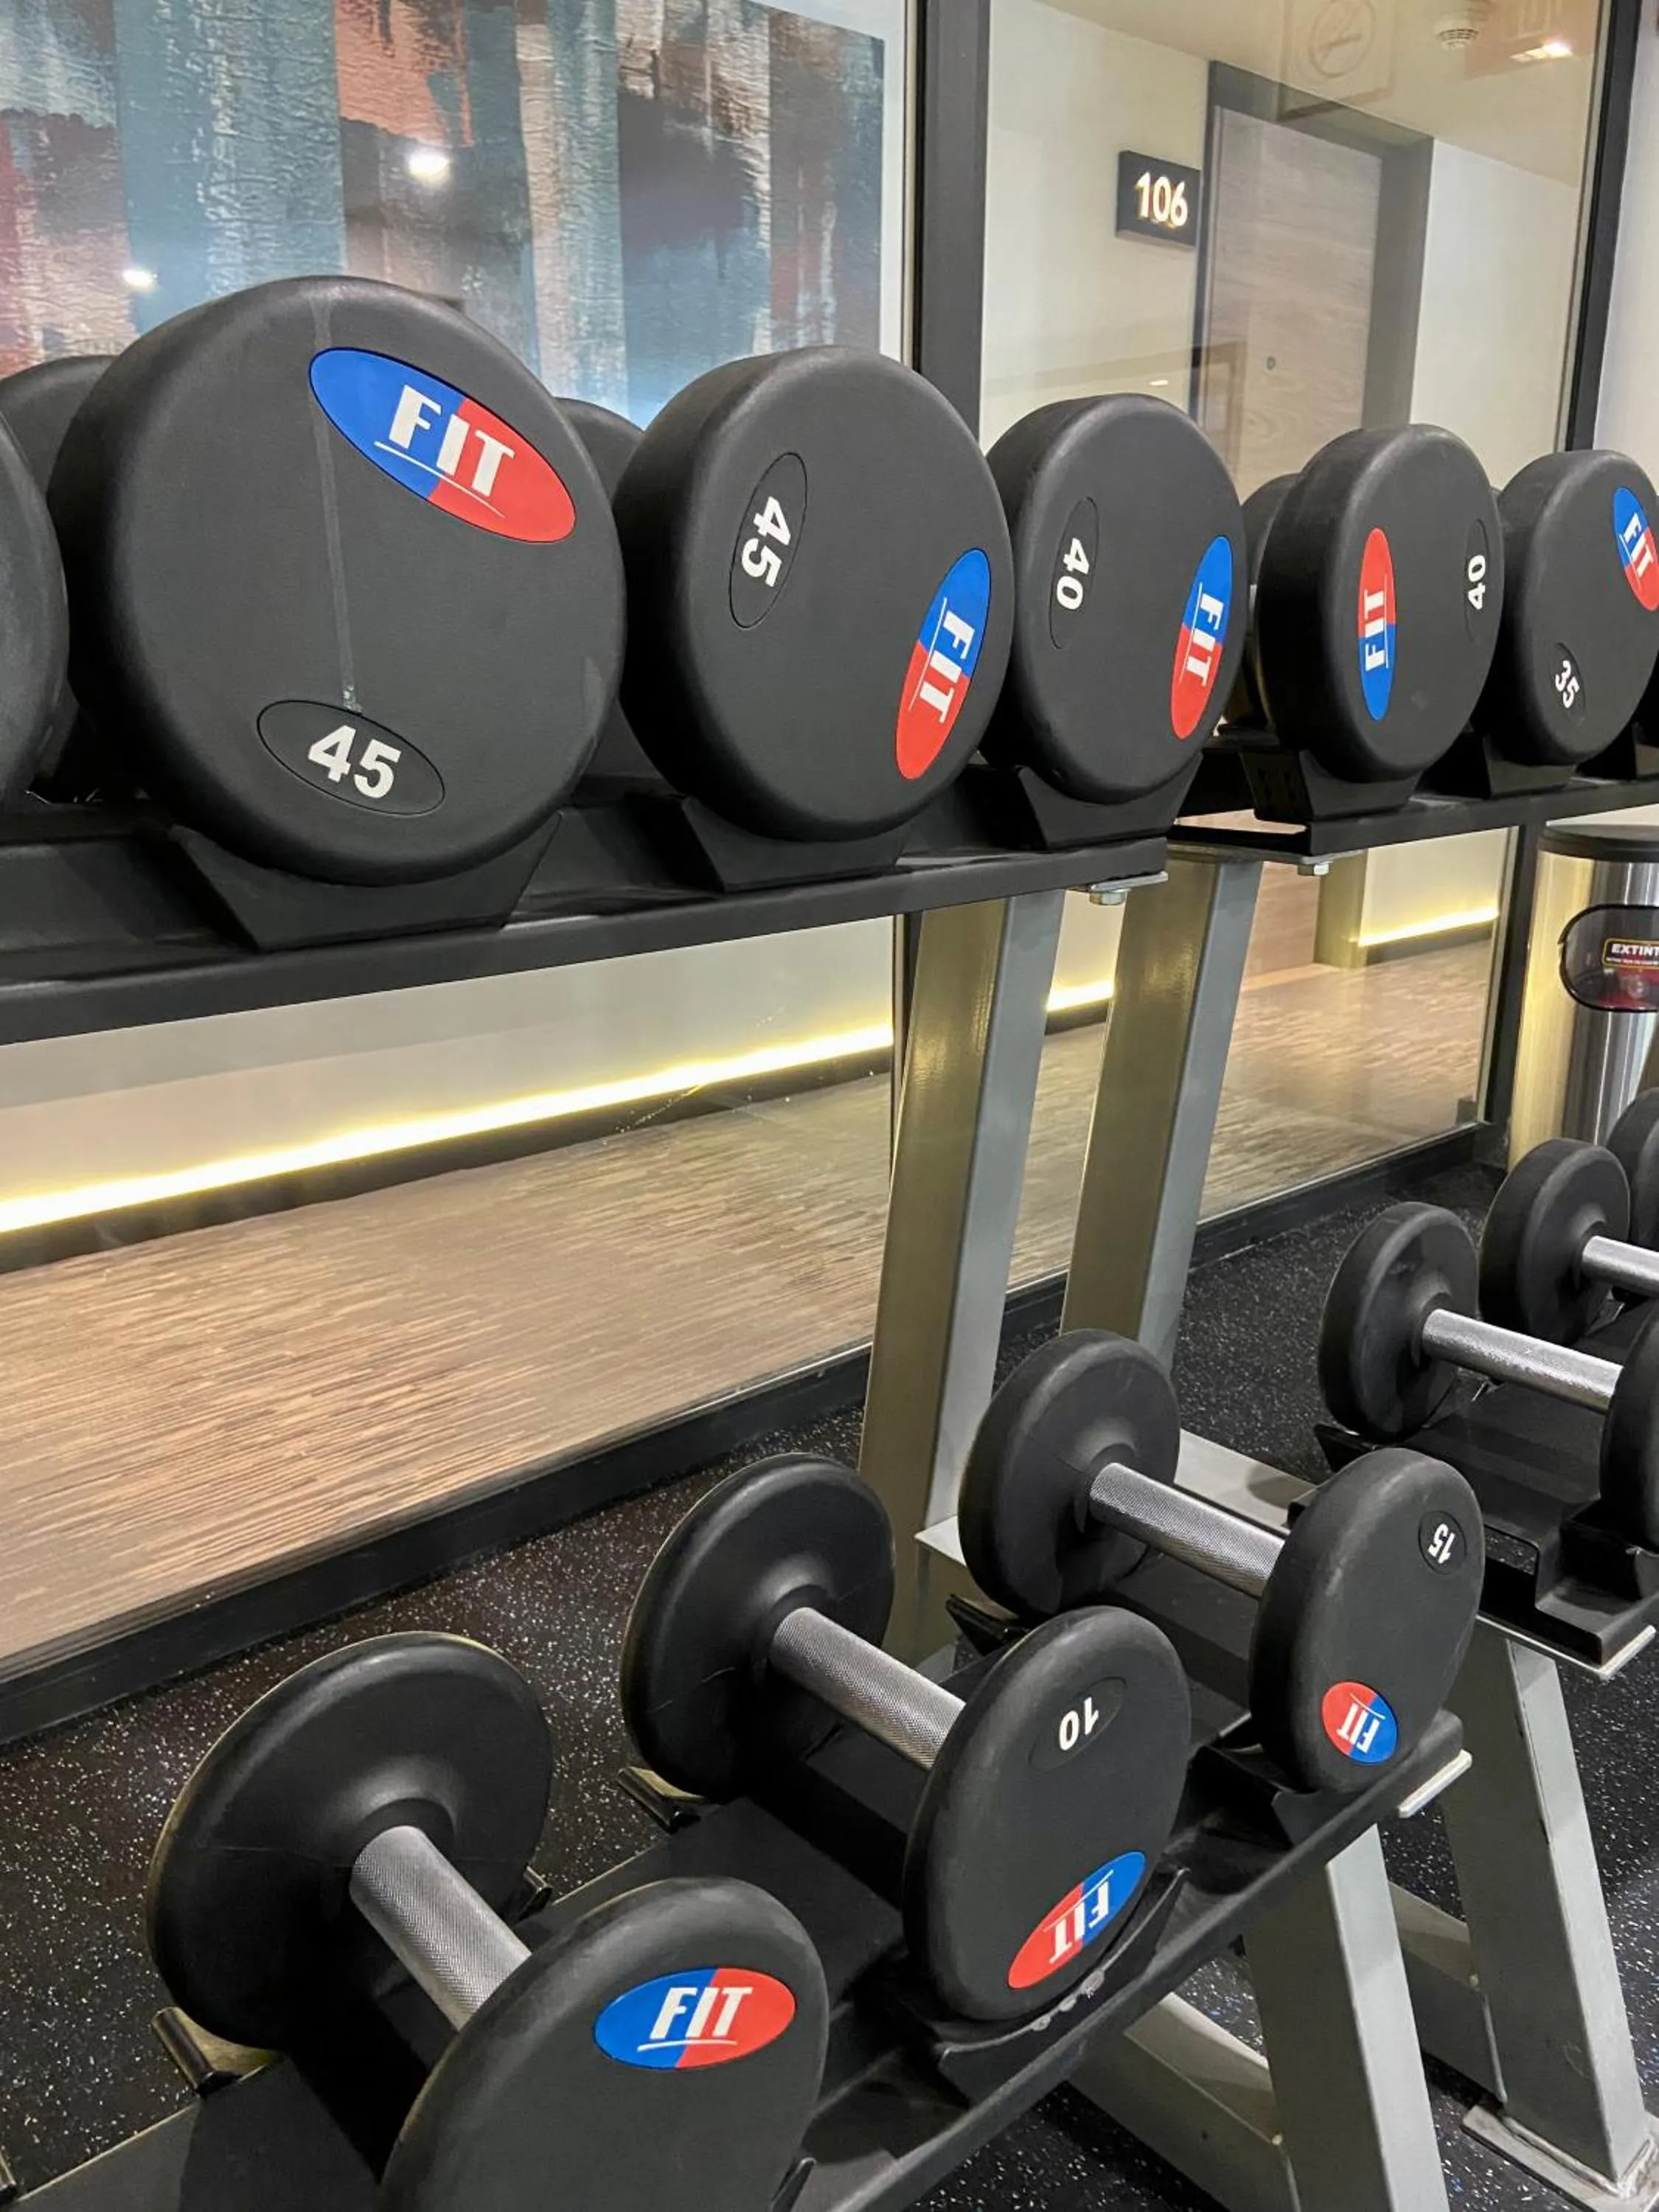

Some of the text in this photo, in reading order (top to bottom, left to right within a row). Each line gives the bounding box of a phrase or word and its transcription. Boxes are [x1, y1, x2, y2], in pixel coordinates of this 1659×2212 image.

[1135, 171, 1188, 226] 106
[389, 384, 515, 498] FIT
[741, 495, 791, 588] 45
[1057, 538, 1090, 611] 40
[1624, 512, 1654, 578] FIT
[1468, 554, 1486, 610] 40
[1186, 592, 1224, 686] FIT
[1364, 589, 1385, 672] FIT
[919, 610, 975, 723] FIT
[1555, 660, 1580, 709] 35
[307, 725, 402, 798] 45
[1427, 1523, 1455, 1564] 15
[1059, 1696, 1099, 1750] 10
[1336, 1703, 1380, 1753] FIT
[1049, 1882, 1109, 1963] FIT
[650, 1987, 753, 2039] FIT
